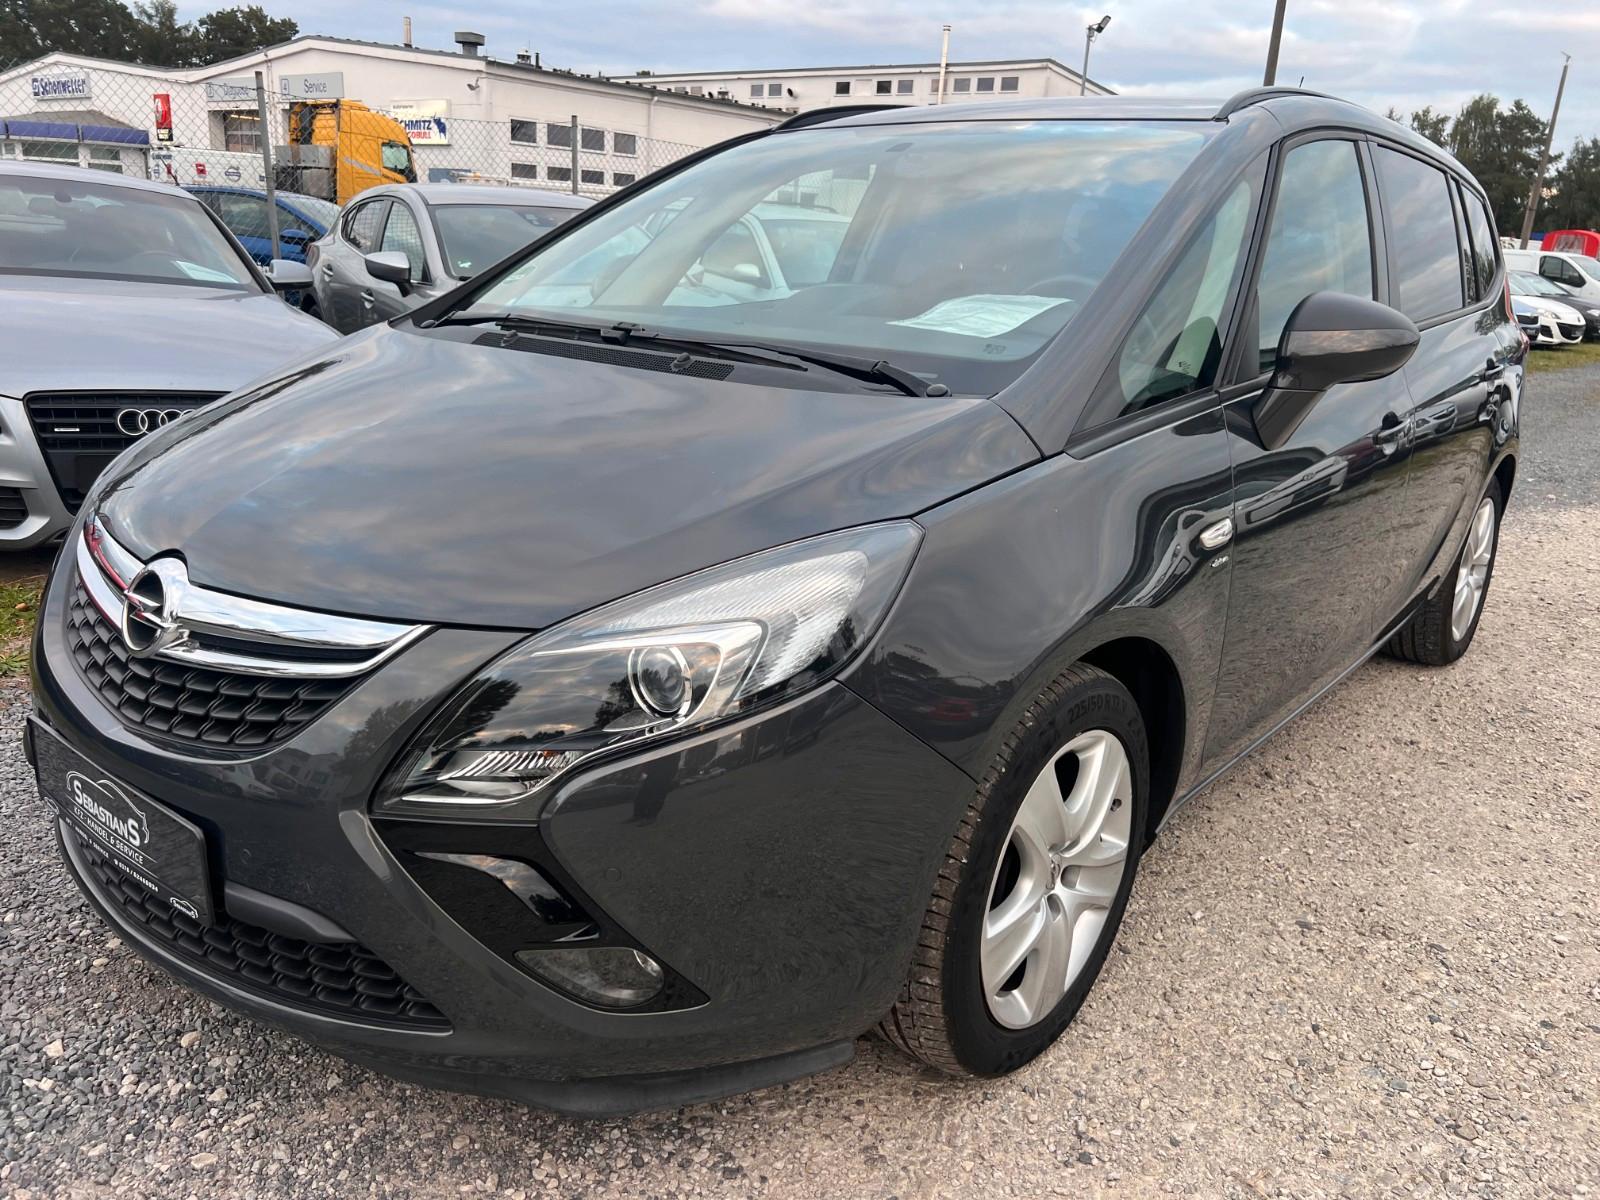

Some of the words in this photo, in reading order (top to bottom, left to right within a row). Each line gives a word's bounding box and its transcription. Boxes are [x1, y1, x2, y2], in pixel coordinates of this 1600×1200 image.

[304, 79, 327, 93] Service
[394, 118, 432, 130] HMITZ
[73, 780, 140, 847] SEBASTIANS
[73, 806, 84, 820] KFZ
[87, 817, 109, 841] HANDEL
[110, 836, 115, 844] &
[115, 841, 144, 865] SERVICE
